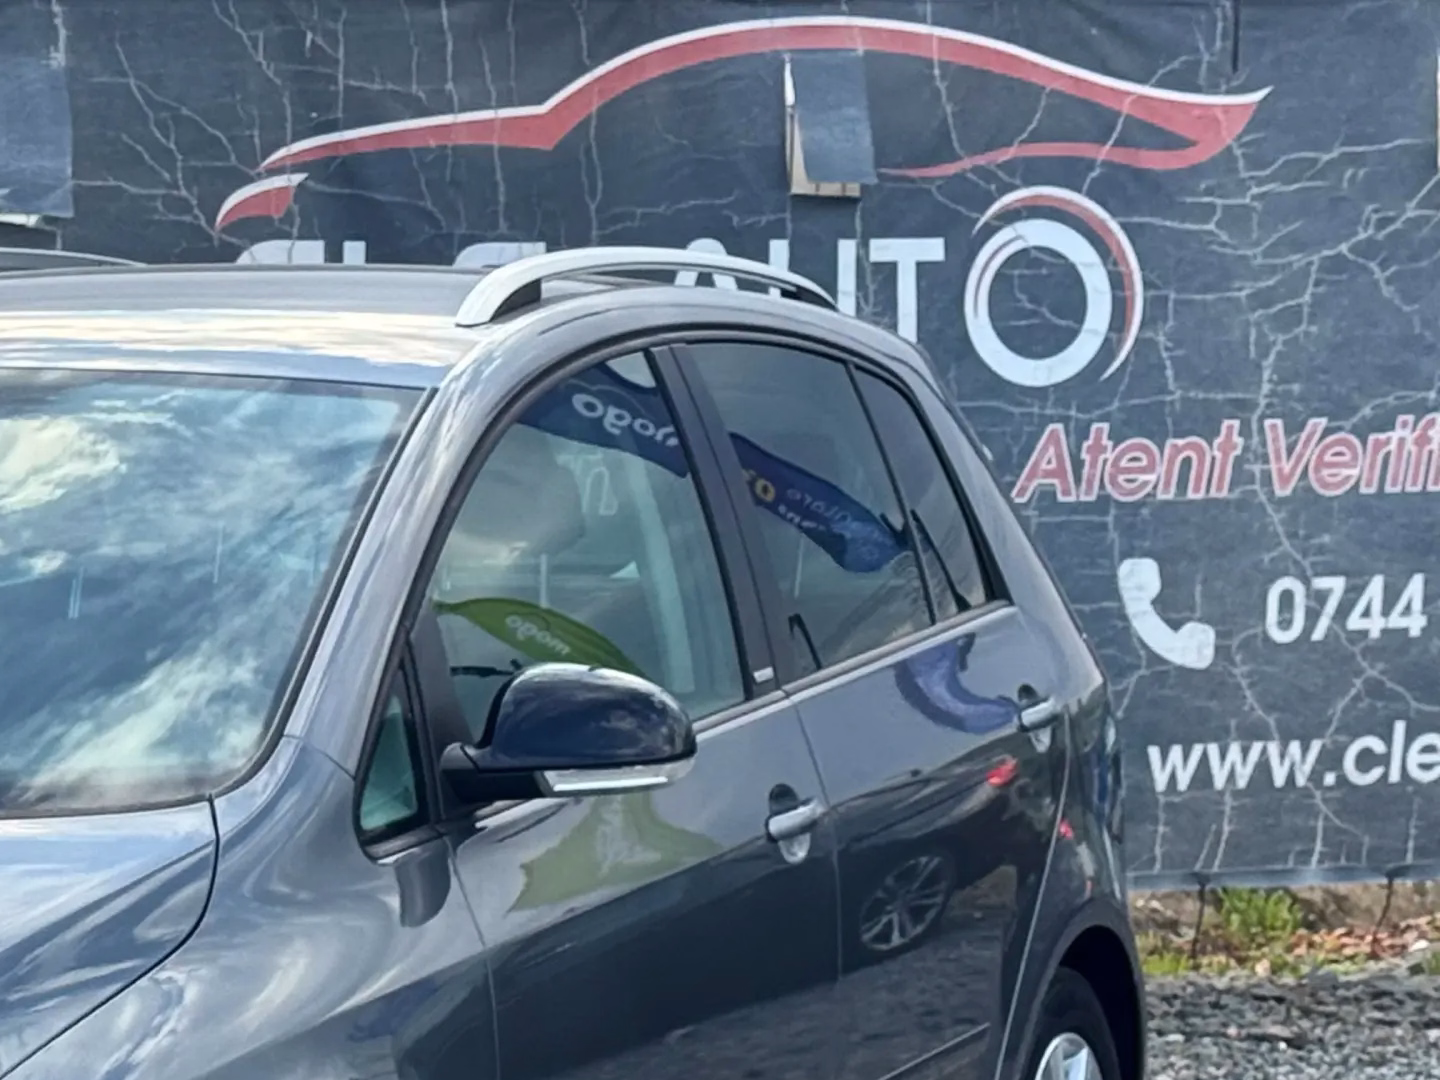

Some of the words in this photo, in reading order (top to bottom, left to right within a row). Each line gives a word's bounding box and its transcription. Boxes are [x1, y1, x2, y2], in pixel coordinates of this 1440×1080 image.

[1012, 420, 1243, 503] Atent
[1266, 573, 1427, 644] 0744
[1148, 720, 1440, 792] www.cle
